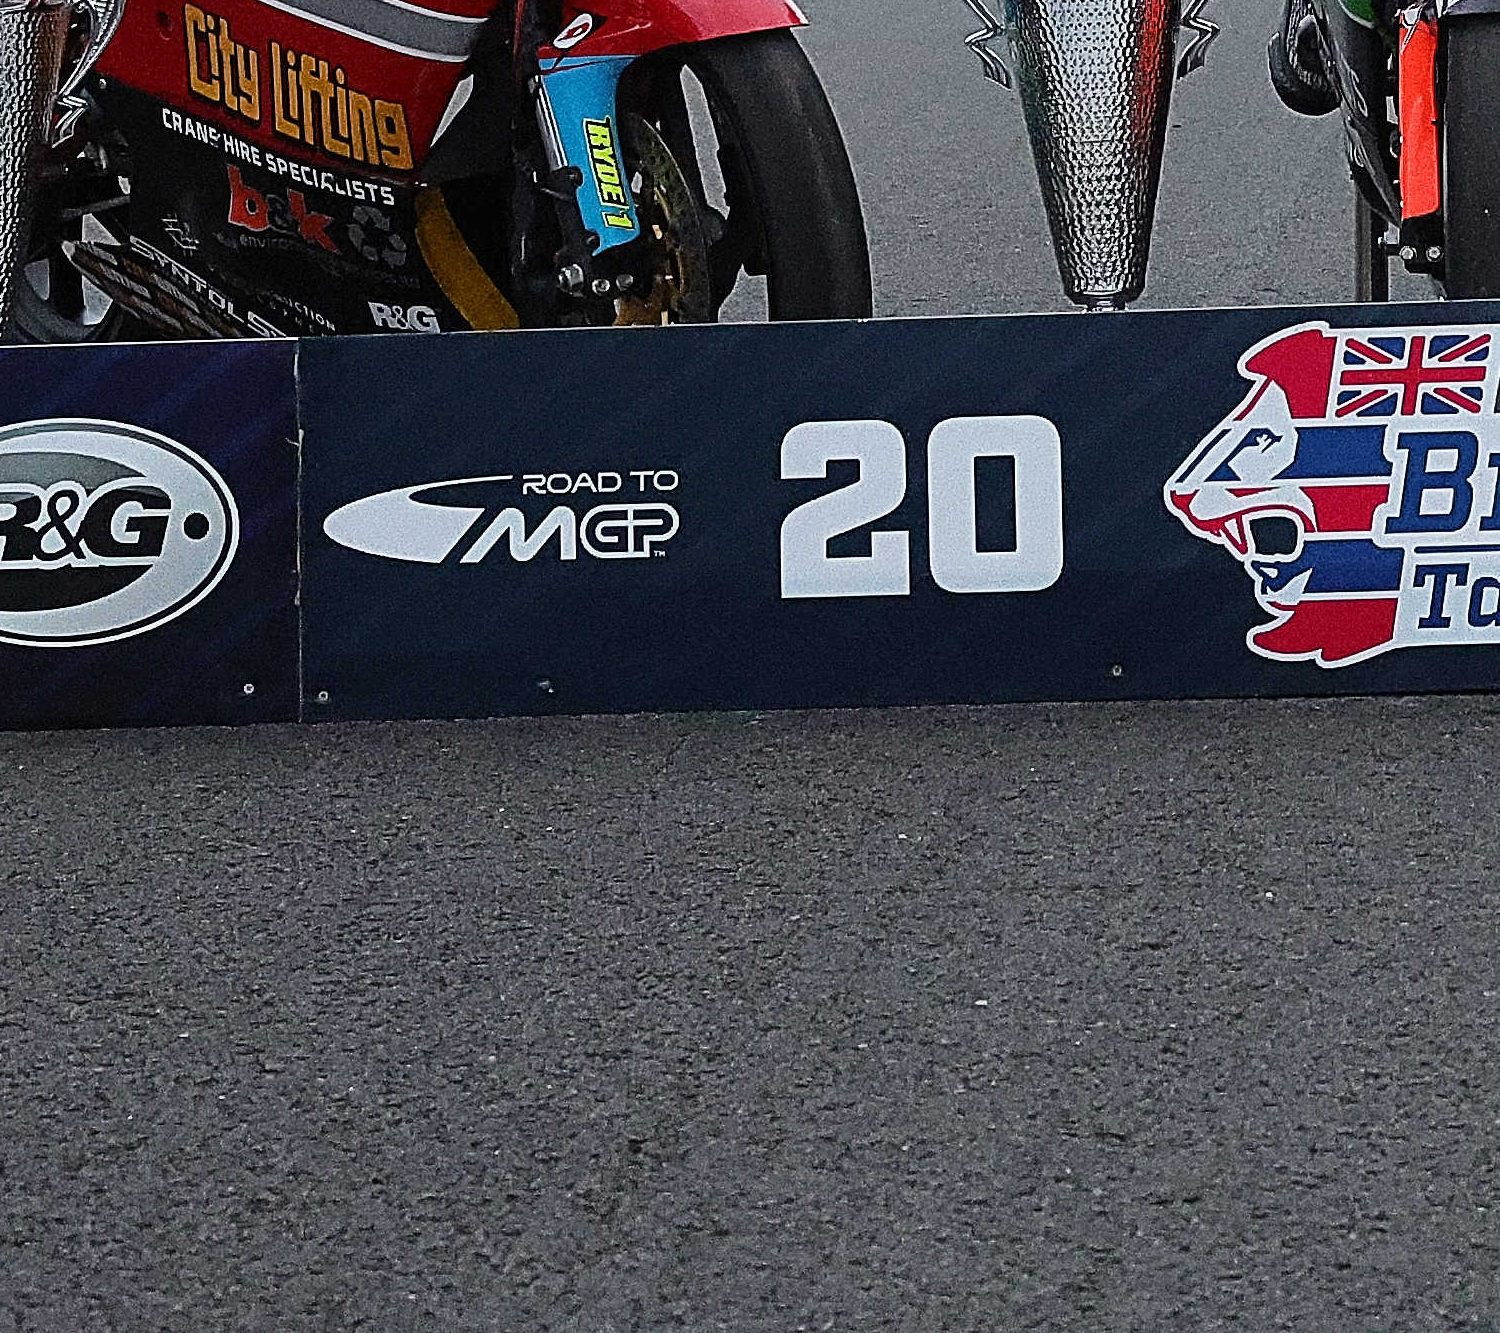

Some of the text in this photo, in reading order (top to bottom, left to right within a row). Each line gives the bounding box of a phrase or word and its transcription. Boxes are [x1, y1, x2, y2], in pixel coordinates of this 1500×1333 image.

[184, 2, 415, 171] City Lifting
[161, 108, 396, 206] CRANE HIRE SPECIALISTS
[583, 115, 627, 207] RYDE
[368, 300, 441, 333] R&G
[522, 470, 679, 495] ROAD TO
[780, 414, 1064, 599] 20
